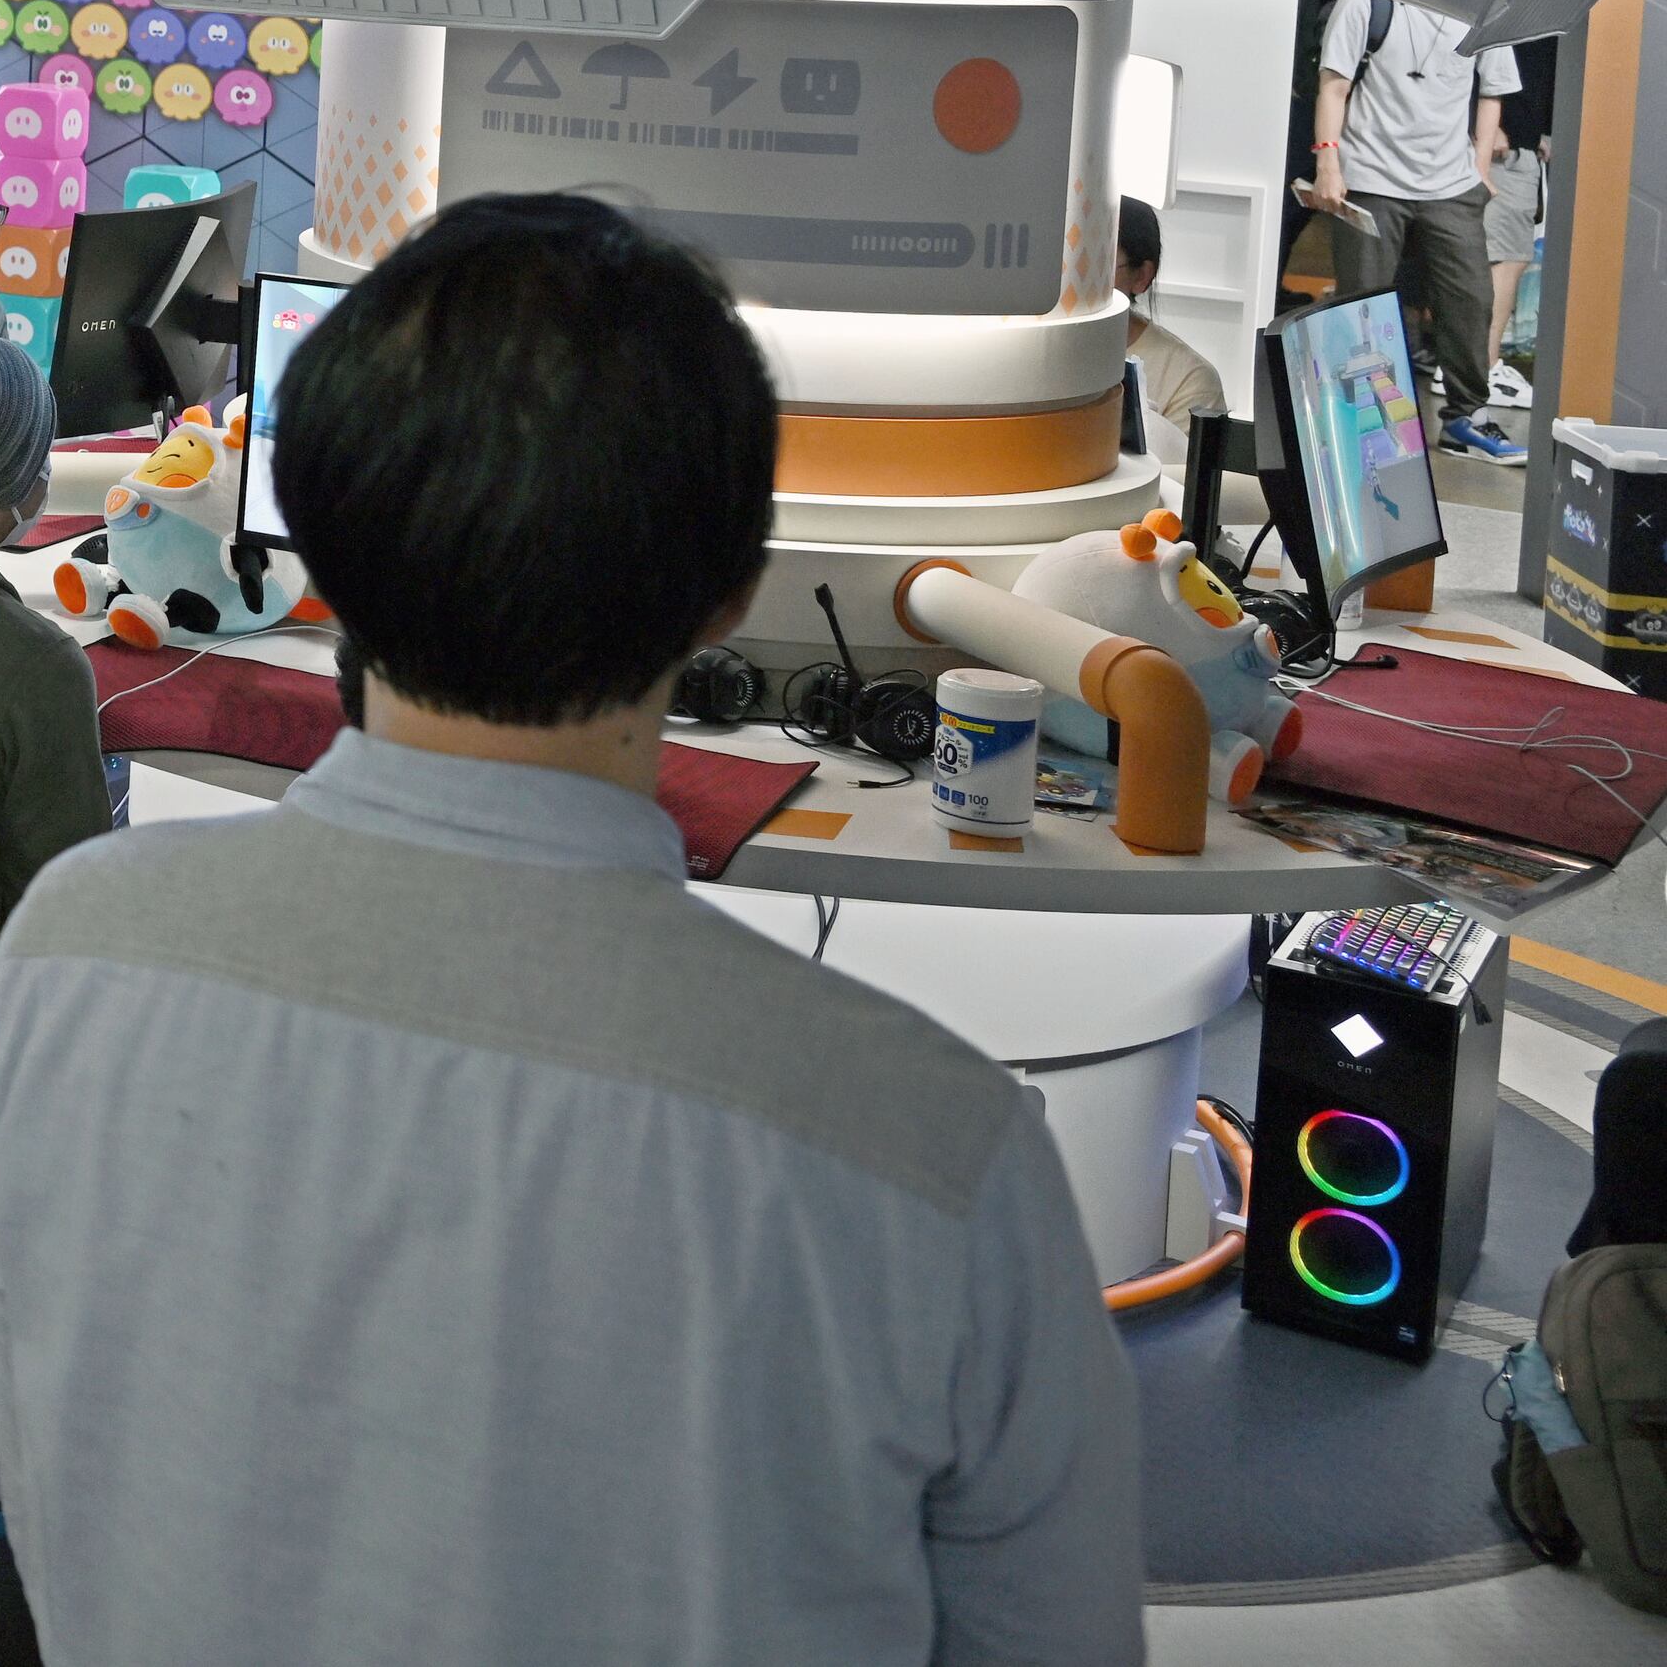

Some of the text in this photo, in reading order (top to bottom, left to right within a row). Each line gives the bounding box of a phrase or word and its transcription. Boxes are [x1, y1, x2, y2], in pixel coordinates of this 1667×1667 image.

[81, 319, 116, 332] OMEN
[935, 739, 958, 766] 60
[968, 794, 989, 806] 100
[1337, 1060, 1372, 1075] OMEN
